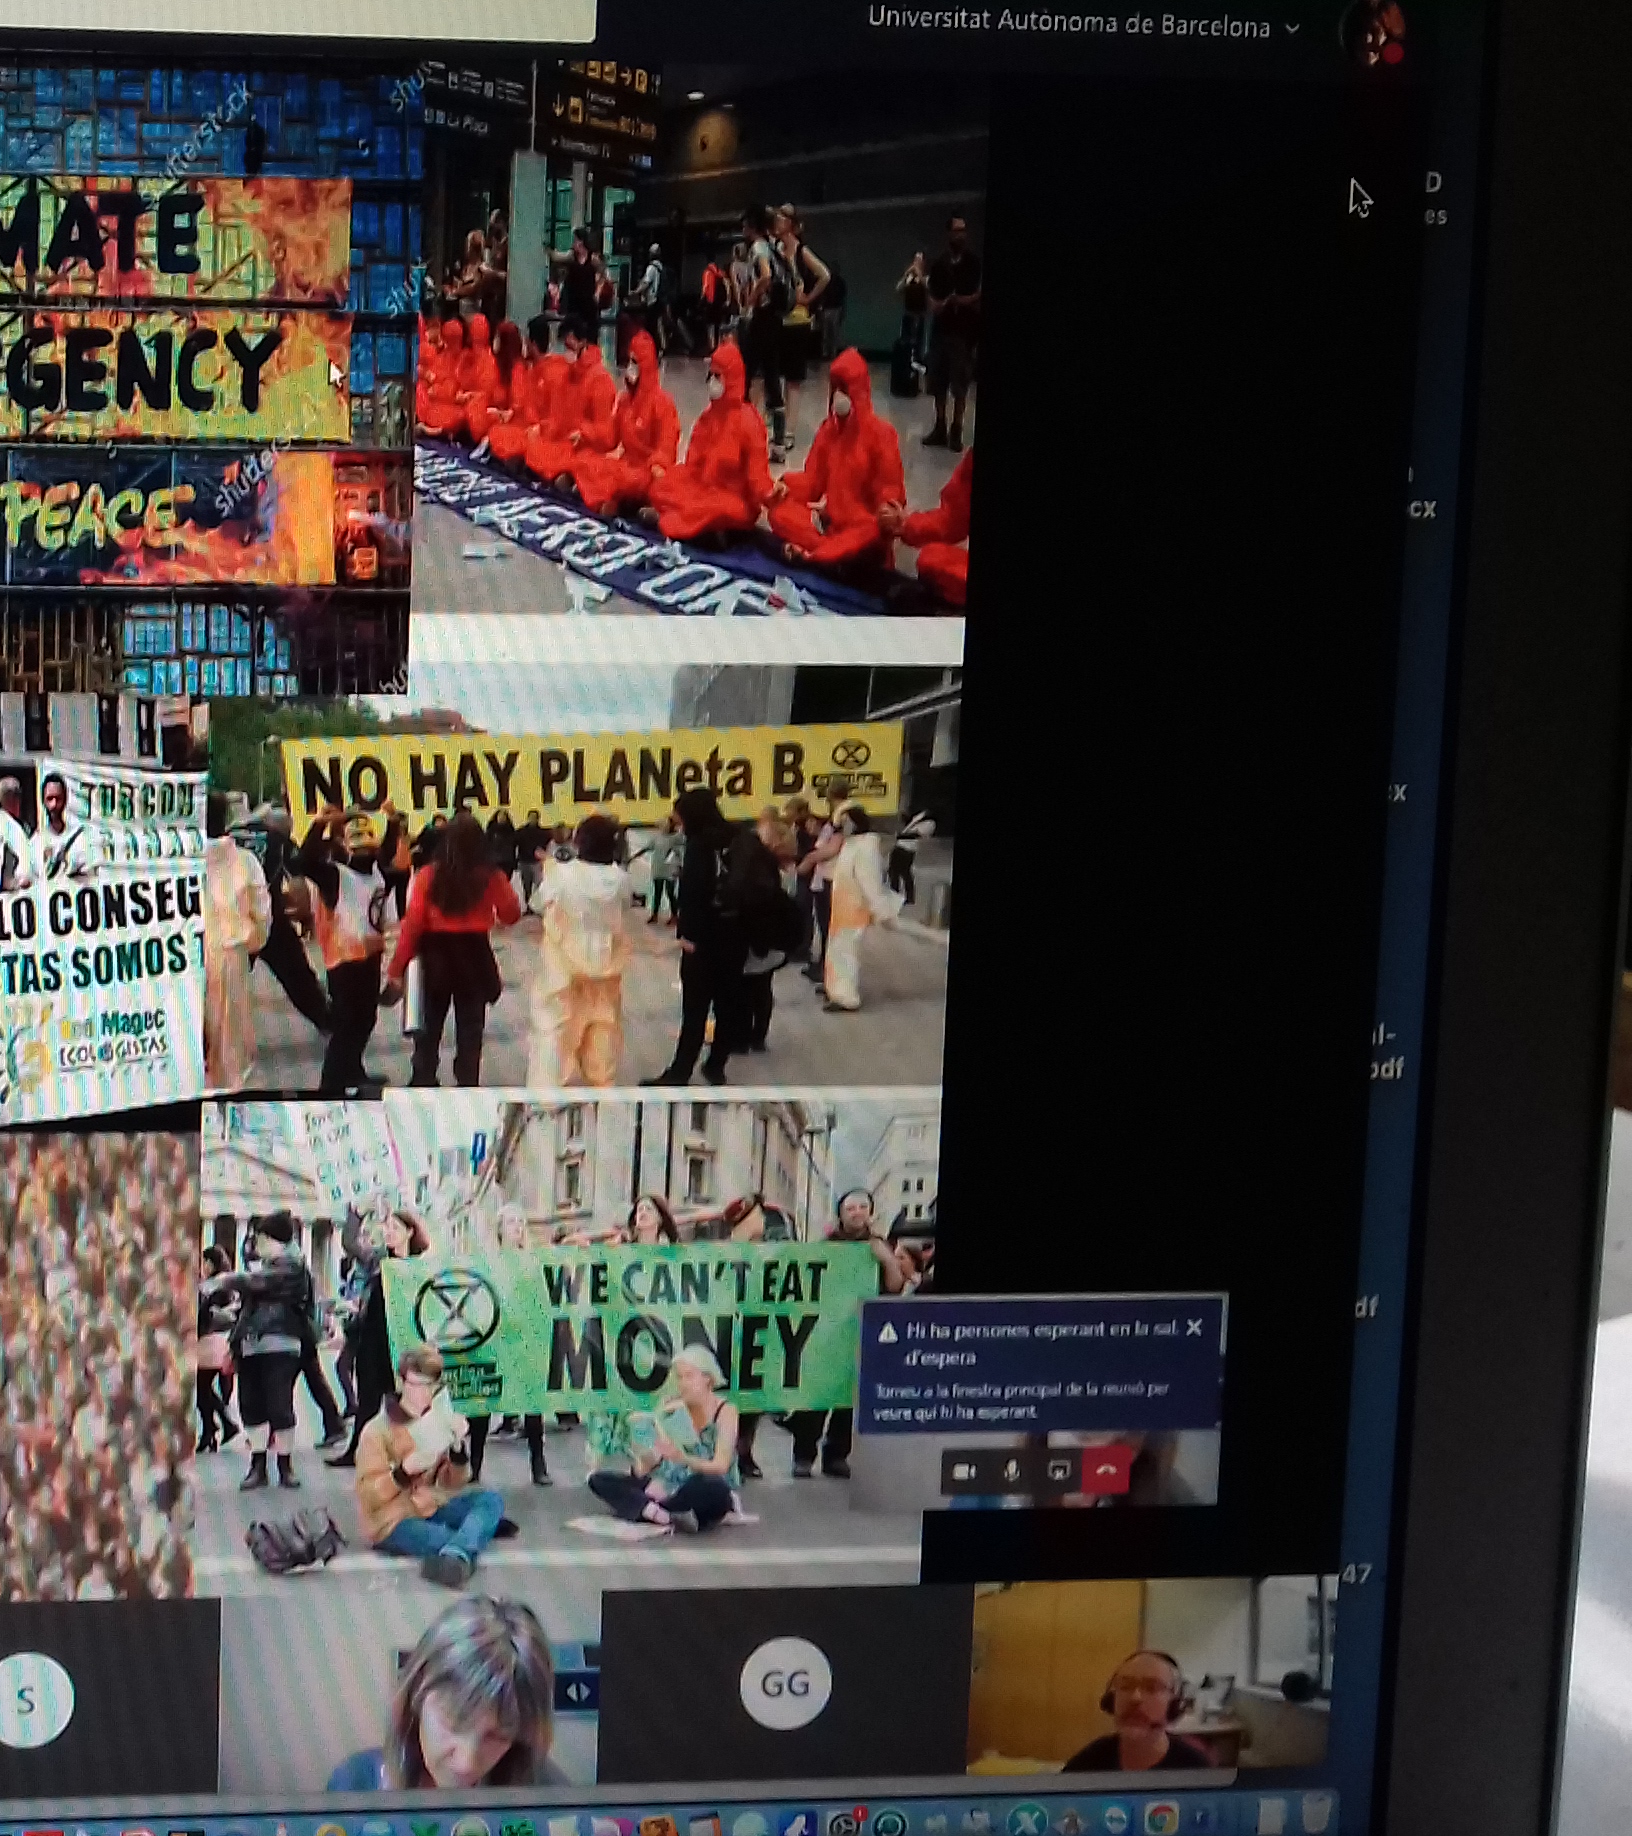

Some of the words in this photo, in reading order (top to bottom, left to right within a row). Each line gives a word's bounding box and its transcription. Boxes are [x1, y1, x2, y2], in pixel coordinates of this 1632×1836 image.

[868, 4, 991, 31] Universitat
[997, 8, 1118, 35] Autònoma
[1125, 12, 1154, 36] de
[1161, 13, 1272, 39] Barcelona
[1425, 173, 1443, 193] D
[301, 755, 390, 813] NO
[410, 746, 521, 815] HAY
[539, 743, 753, 805] PLANeta
[772, 743, 806, 795] B
[73, 931, 189, 988] SOMOS
[542, 1262, 611, 1305] WE
[620, 1259, 751, 1304] CAN'T
[766, 1260, 829, 1302] EAT
[546, 1313, 820, 1392] MONEY
[1342, 1561, 1374, 1586] 47
[16, 1687, 35, 1714] S
[760, 1669, 811, 1698] GG
